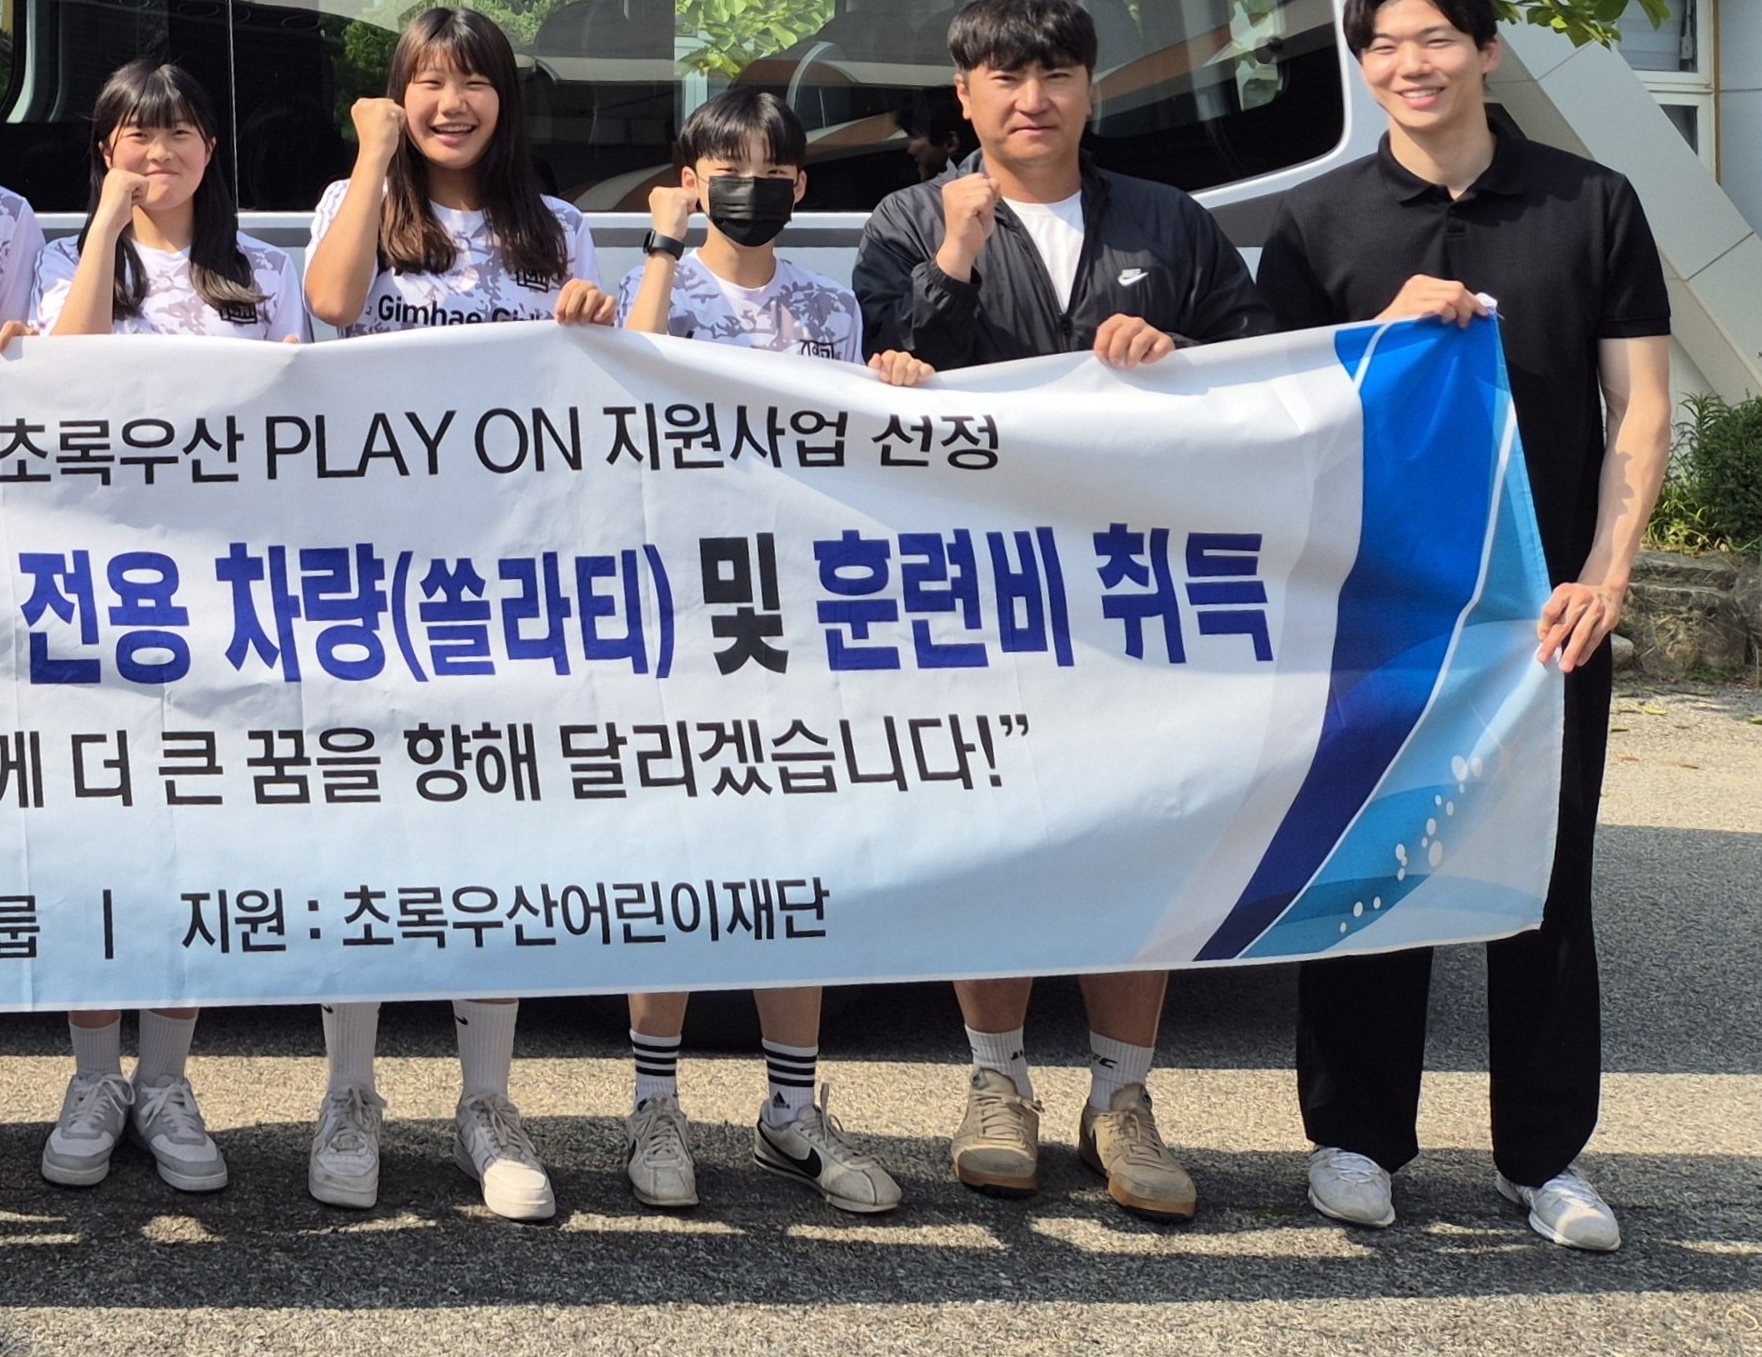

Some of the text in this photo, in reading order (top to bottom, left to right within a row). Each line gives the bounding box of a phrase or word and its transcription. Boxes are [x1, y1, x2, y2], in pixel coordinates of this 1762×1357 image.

[266, 411, 456, 479] PLAY
[475, 407, 582, 473] ON
[603, 403, 848, 470] 지원사업
[872, 416, 998, 470] 선정
[19, 550, 190, 685] 전용
[699, 533, 788, 675] 및
[813, 527, 1074, 670] 훈련비
[1093, 523, 1273, 663] 취득
[71, 730, 132, 806] 더
[159, 731, 223, 805] 큰
[247, 727, 380, 804] 꿈을
[403, 722, 541, 801] 향해
[560, 714, 1028, 799] 달리겠습니다!”
[181, 889, 286, 953] 지원
[343, 878, 830, 948] 초록우산어린이재단
